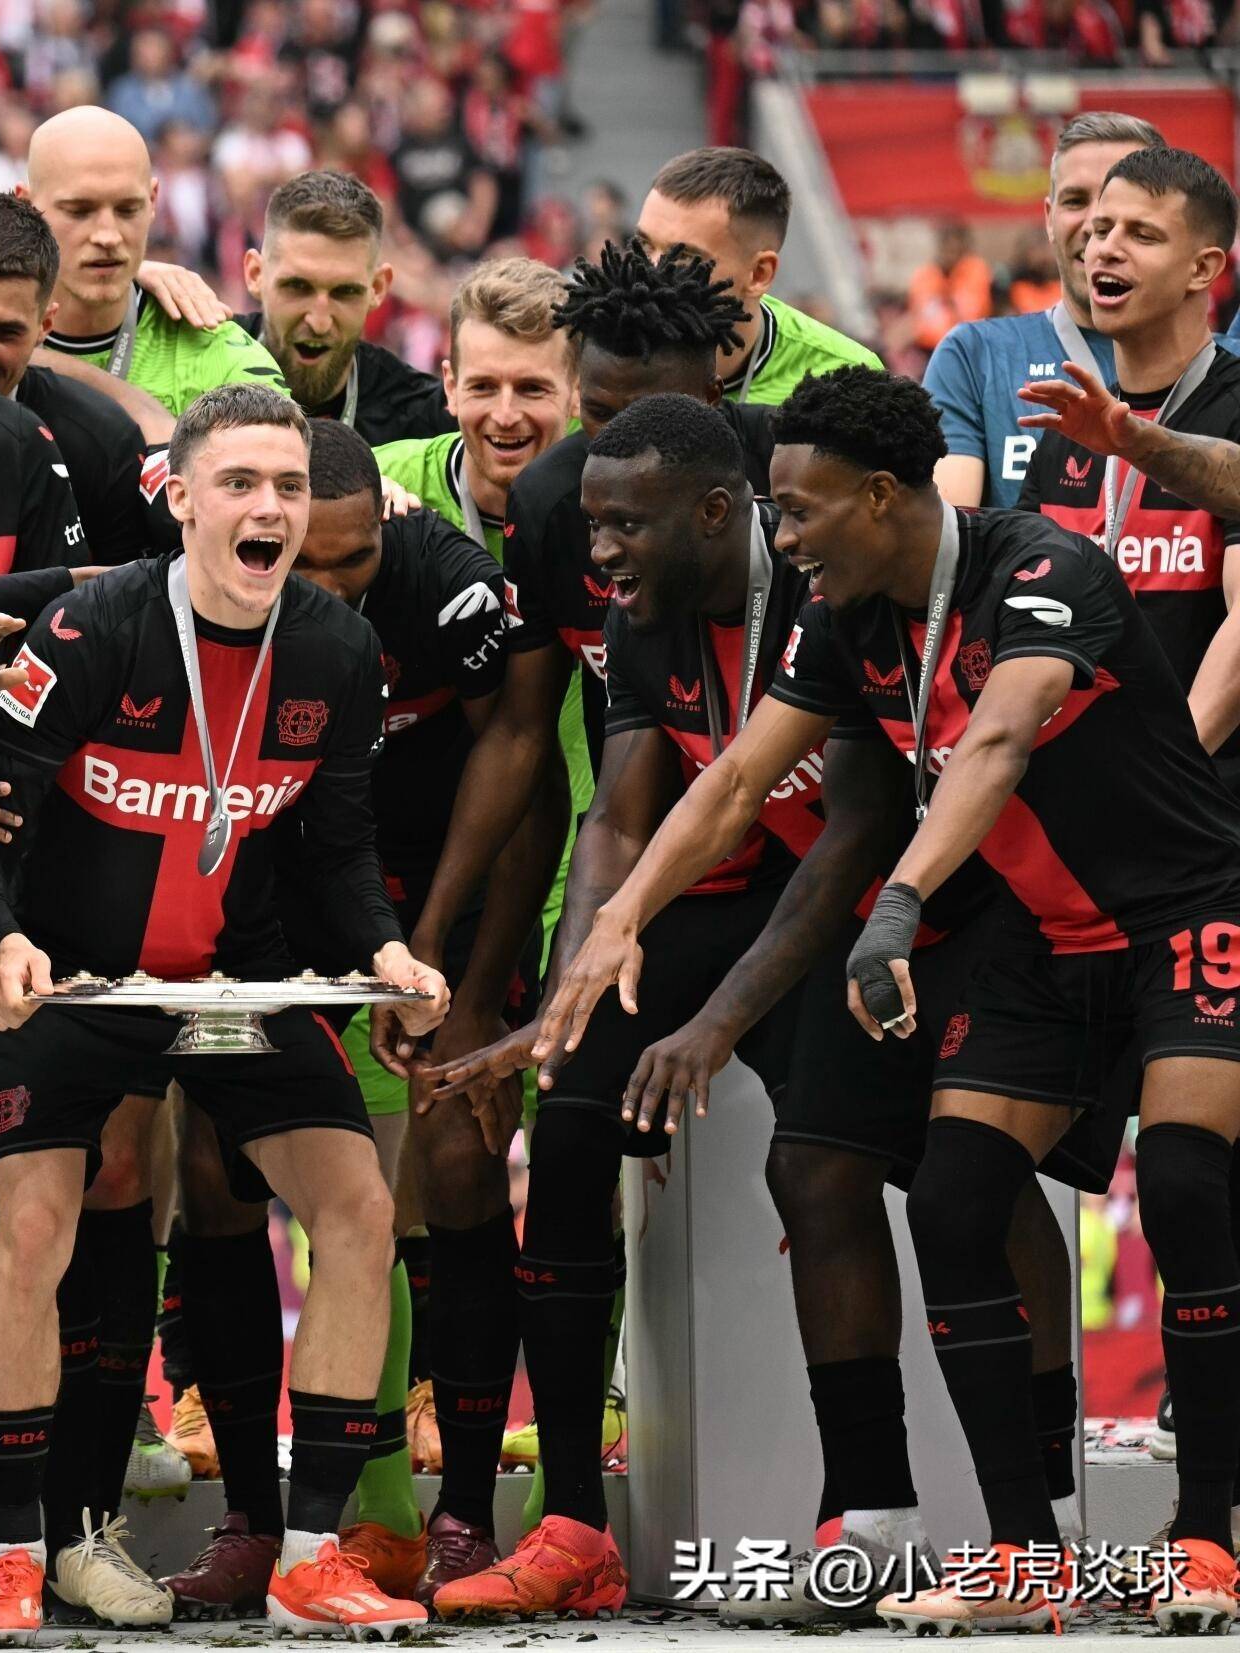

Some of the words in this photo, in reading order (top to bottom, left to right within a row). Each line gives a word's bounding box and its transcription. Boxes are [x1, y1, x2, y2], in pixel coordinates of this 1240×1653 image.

[118, 332, 130, 358] 2024
[1029, 362, 1056, 376] MK
[752, 592, 763, 619] 2024
[932, 593, 946, 619] 2024
[175, 606, 186, 631] 2024
[116, 718, 156, 729] CASTORE
[84, 755, 304, 822] Barmenia
[1169, 921, 1240, 990] 19
[1194, 1017, 1235, 1027] CASTORE
[1176, 1305, 1229, 1321] B04
[0, 1430, 47, 1445] B04
